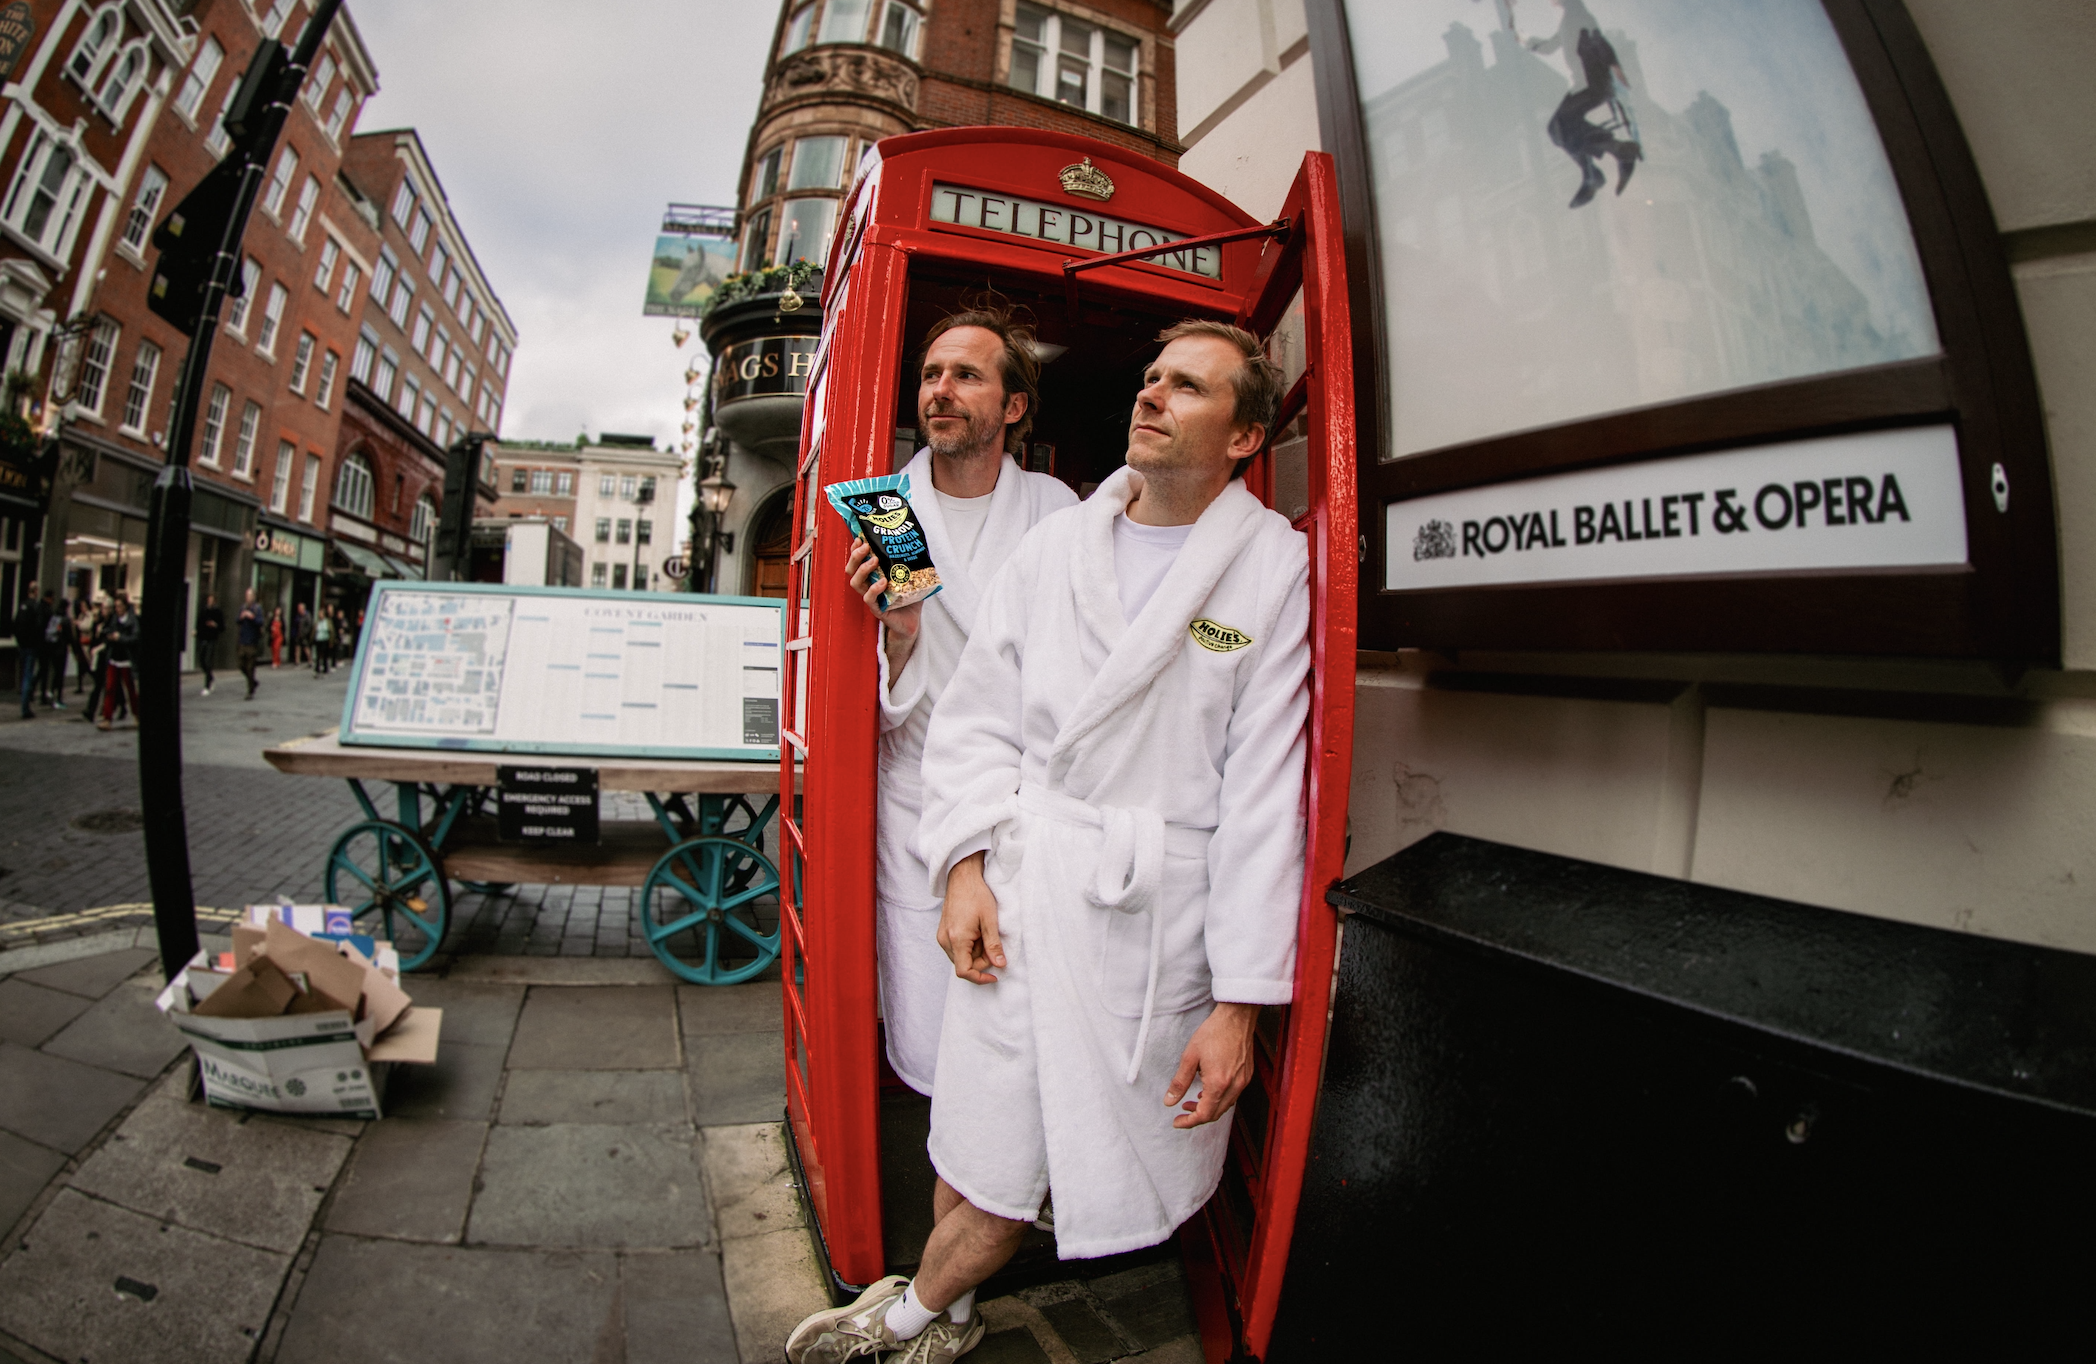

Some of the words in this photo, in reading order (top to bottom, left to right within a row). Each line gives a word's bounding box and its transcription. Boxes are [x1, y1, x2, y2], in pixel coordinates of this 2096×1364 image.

[943, 190, 1211, 276] TELEPHONE
[1462, 510, 1567, 558] ROYAL
[1574, 492, 1704, 545] BALLET
[1712, 488, 1749, 534] &
[1754, 473, 1911, 531] OPERA
[873, 520, 915, 537] GRANOLA
[881, 529, 919, 545] PROTEIN
[886, 539, 923, 554] CRUNCH
[515, 771, 541, 782] ROAD
[542, 772, 578, 783] CLOSED
[503, 792, 556, 804] EMERGENCY
[557, 795, 592, 805] ACCESS
[524, 805, 571, 816] REQUIRED
[522, 826, 545, 836] KEEP
[545, 827, 575, 837] CLEAR
